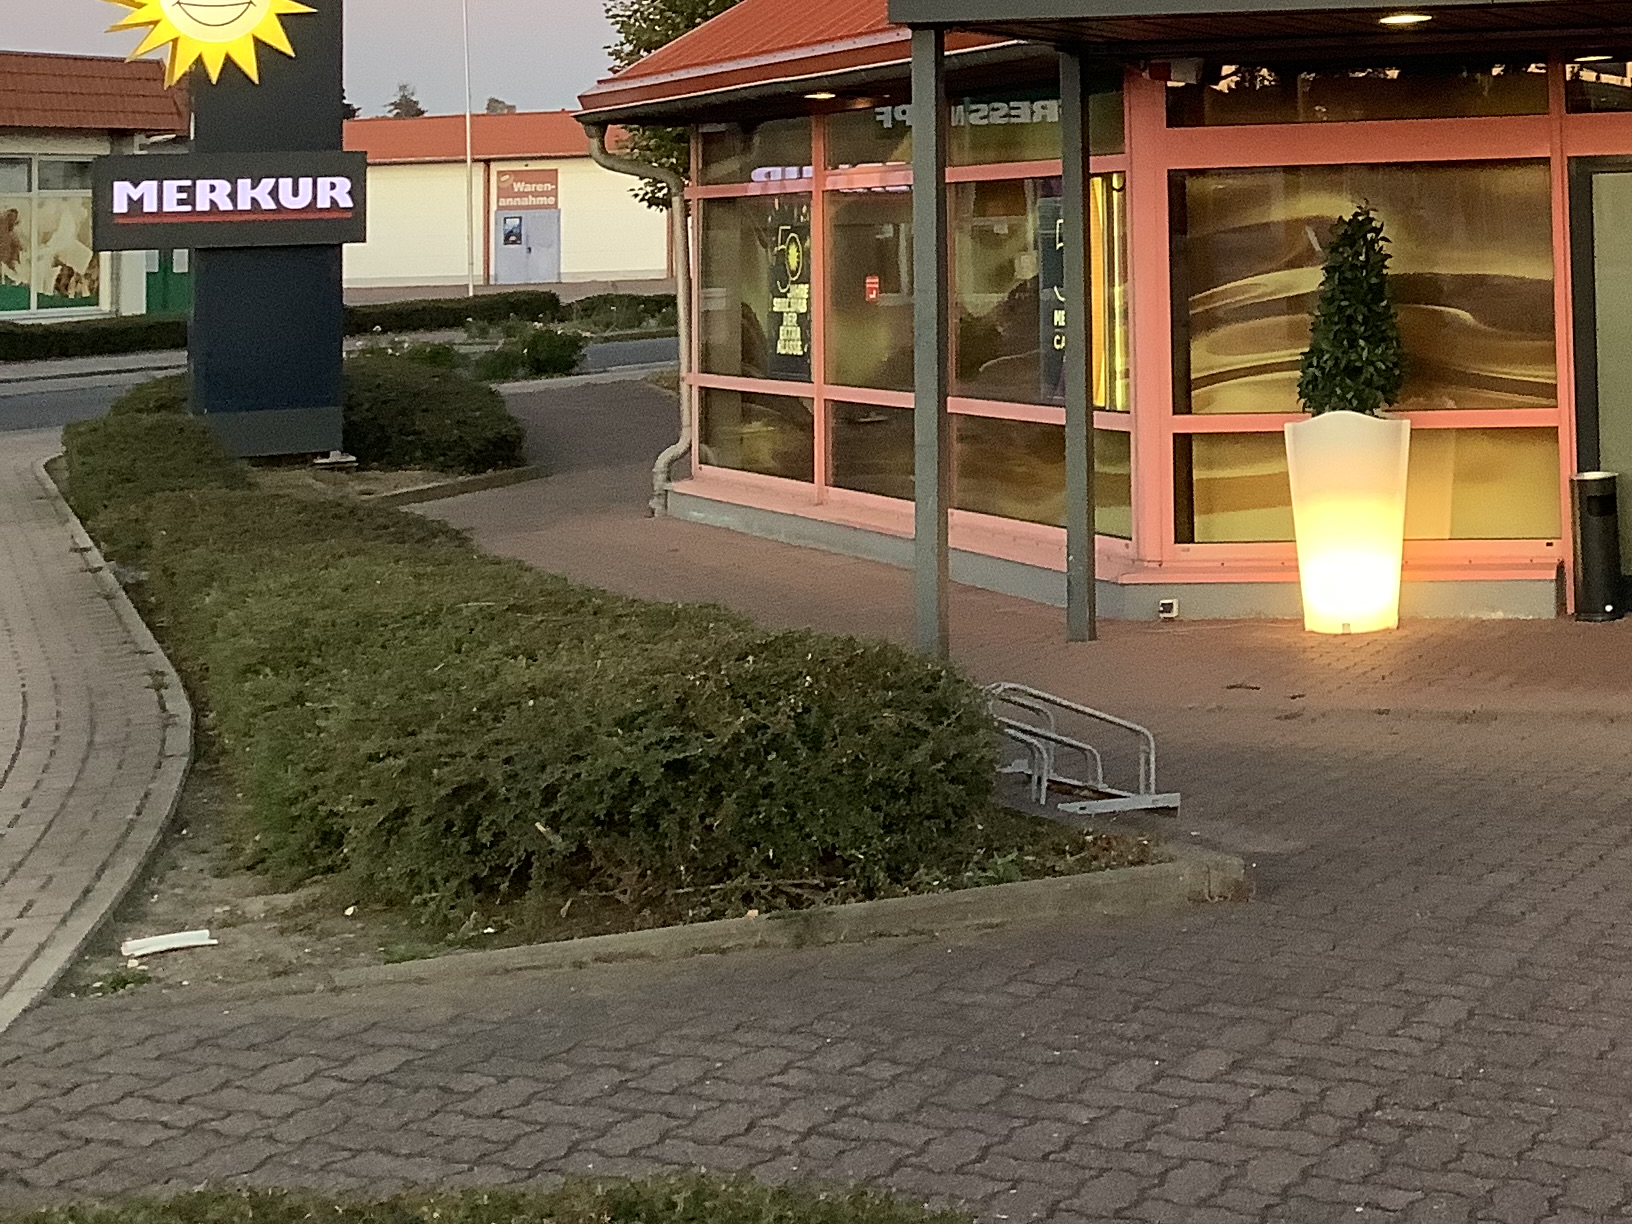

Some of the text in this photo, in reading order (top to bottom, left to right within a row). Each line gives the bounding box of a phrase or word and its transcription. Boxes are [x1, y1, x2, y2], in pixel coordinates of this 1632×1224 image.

[512, 181, 556, 192] Waren-
[113, 176, 354, 213] MERKUR
[498, 195, 556, 206] annahme
